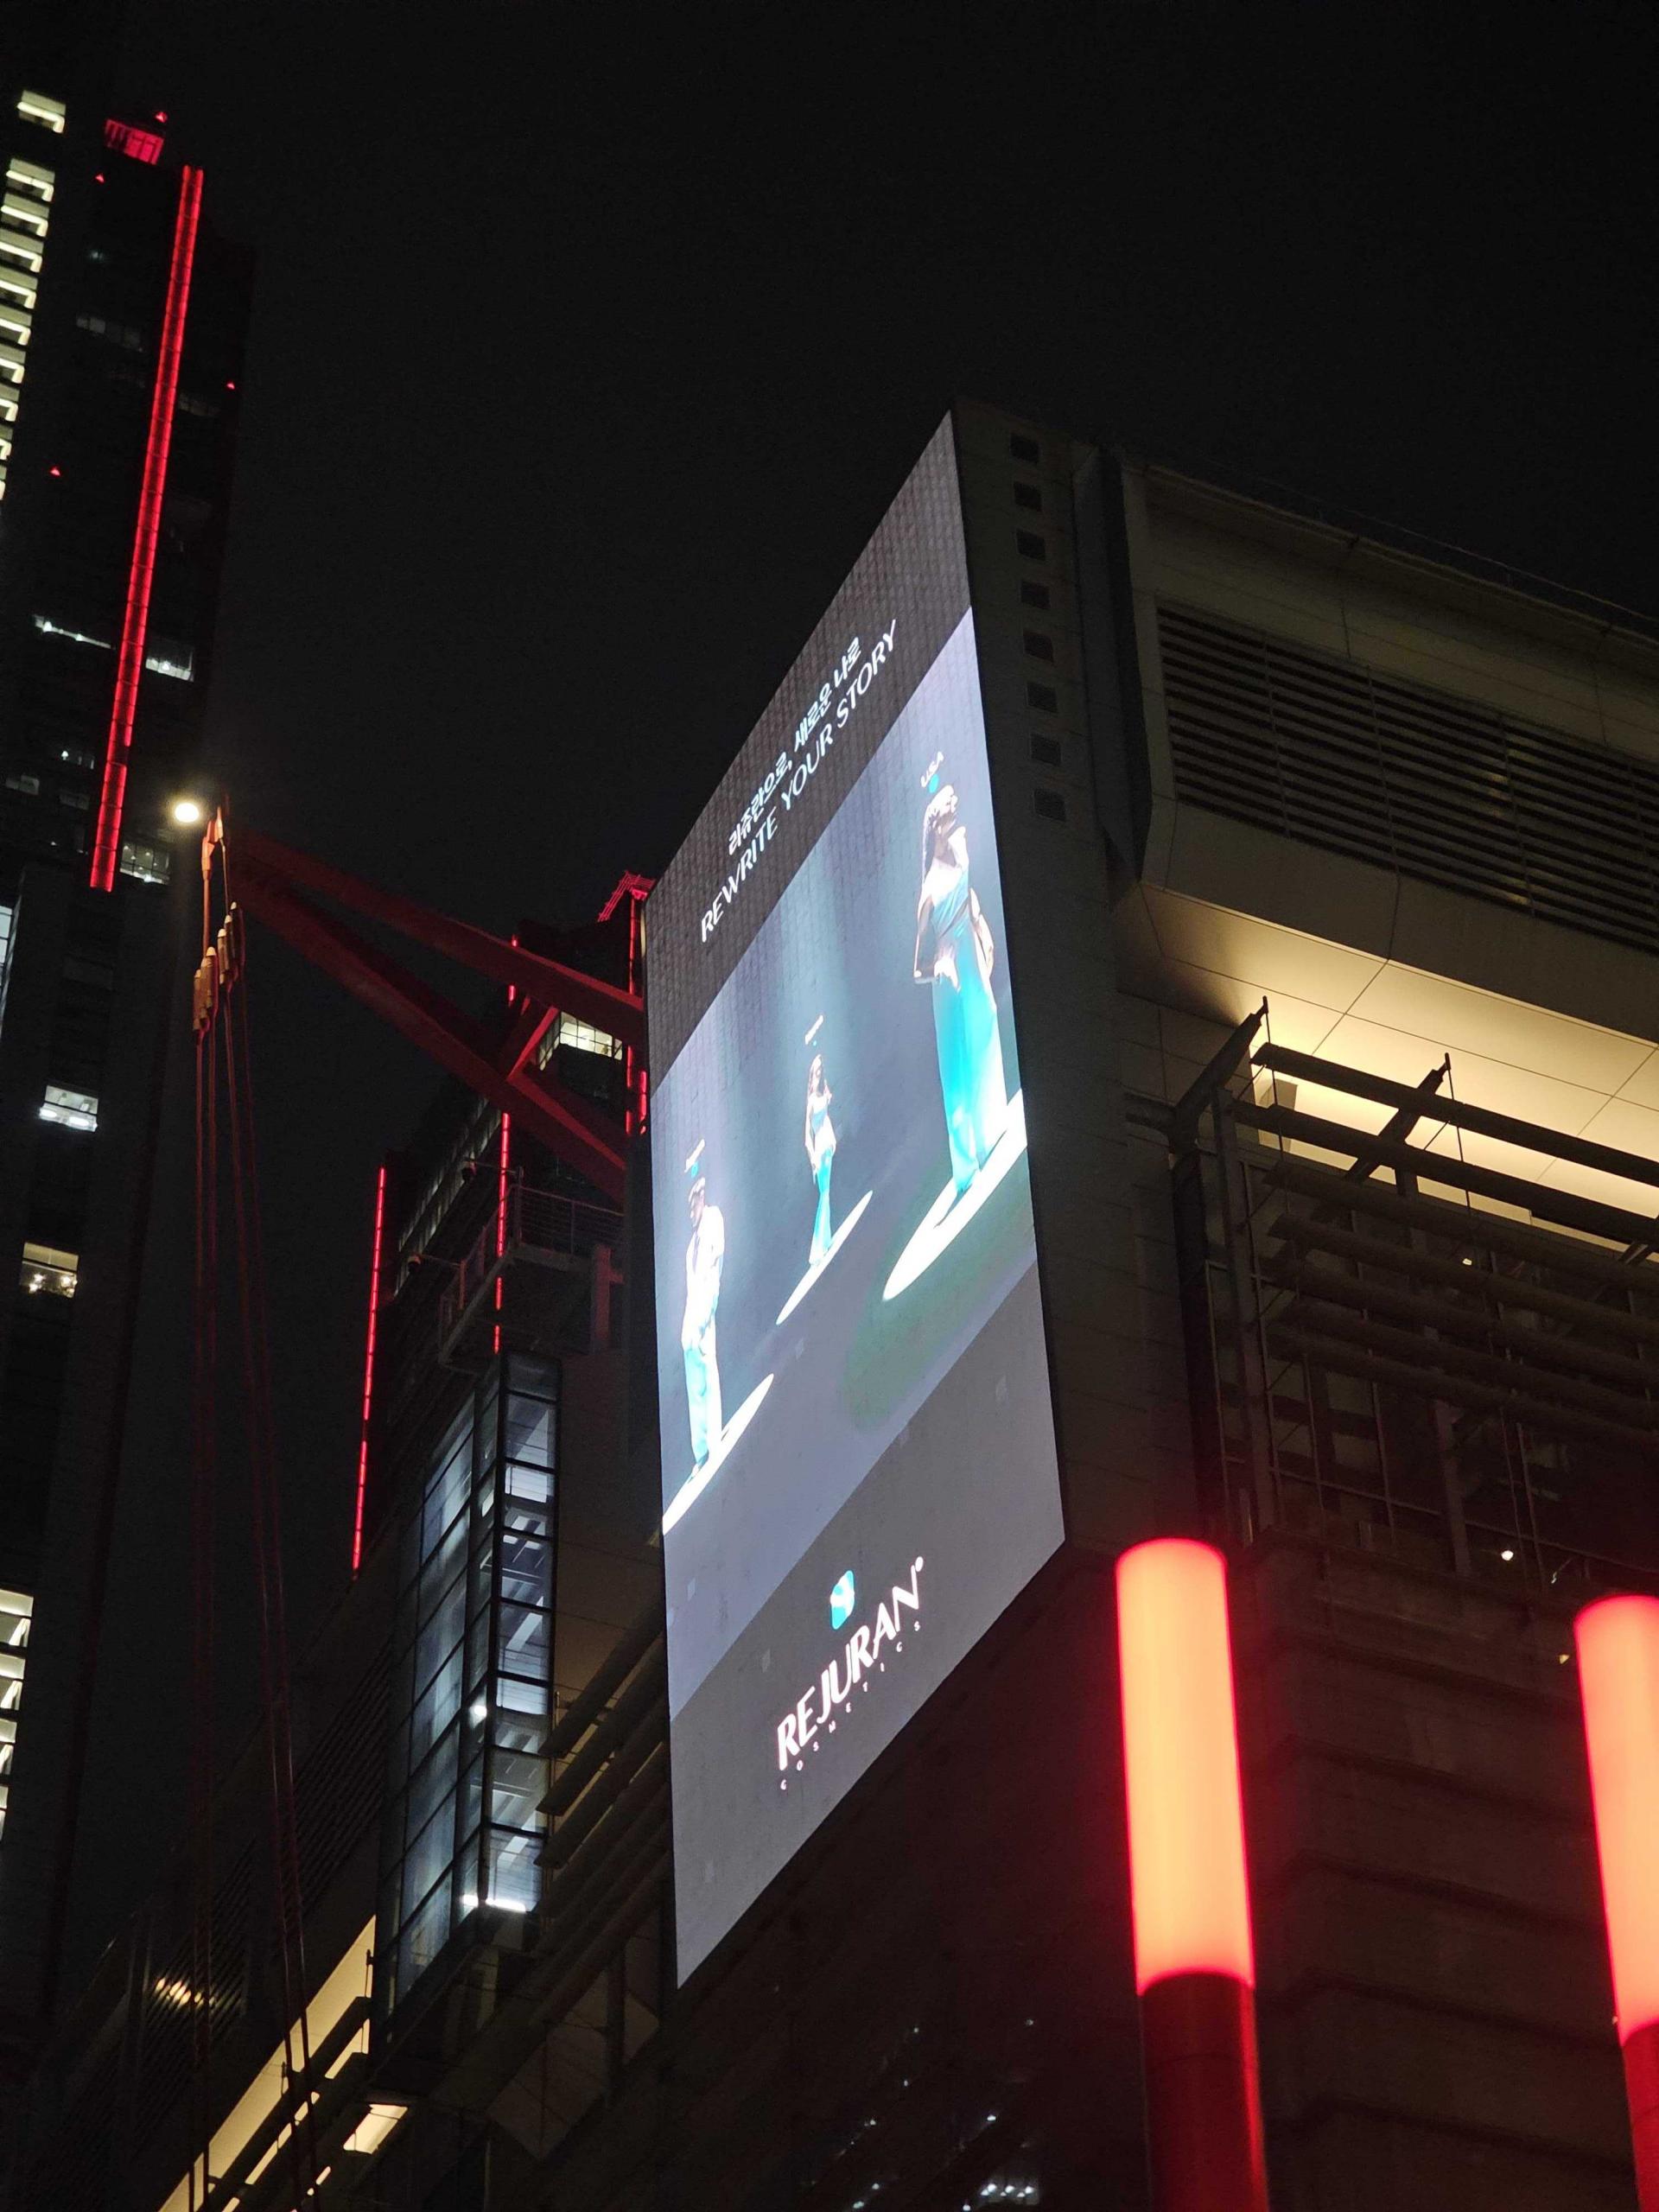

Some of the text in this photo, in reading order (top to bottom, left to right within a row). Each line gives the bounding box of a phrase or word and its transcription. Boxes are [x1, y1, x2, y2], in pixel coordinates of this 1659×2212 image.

[701, 619, 897, 943] REWRITE YOUR STORY
[728, 637, 861, 855] 리쥬란으로, 새로운 나로
[777, 1565, 920, 1771] REJURAN
[780, 1621, 920, 1790] COSMETICS
